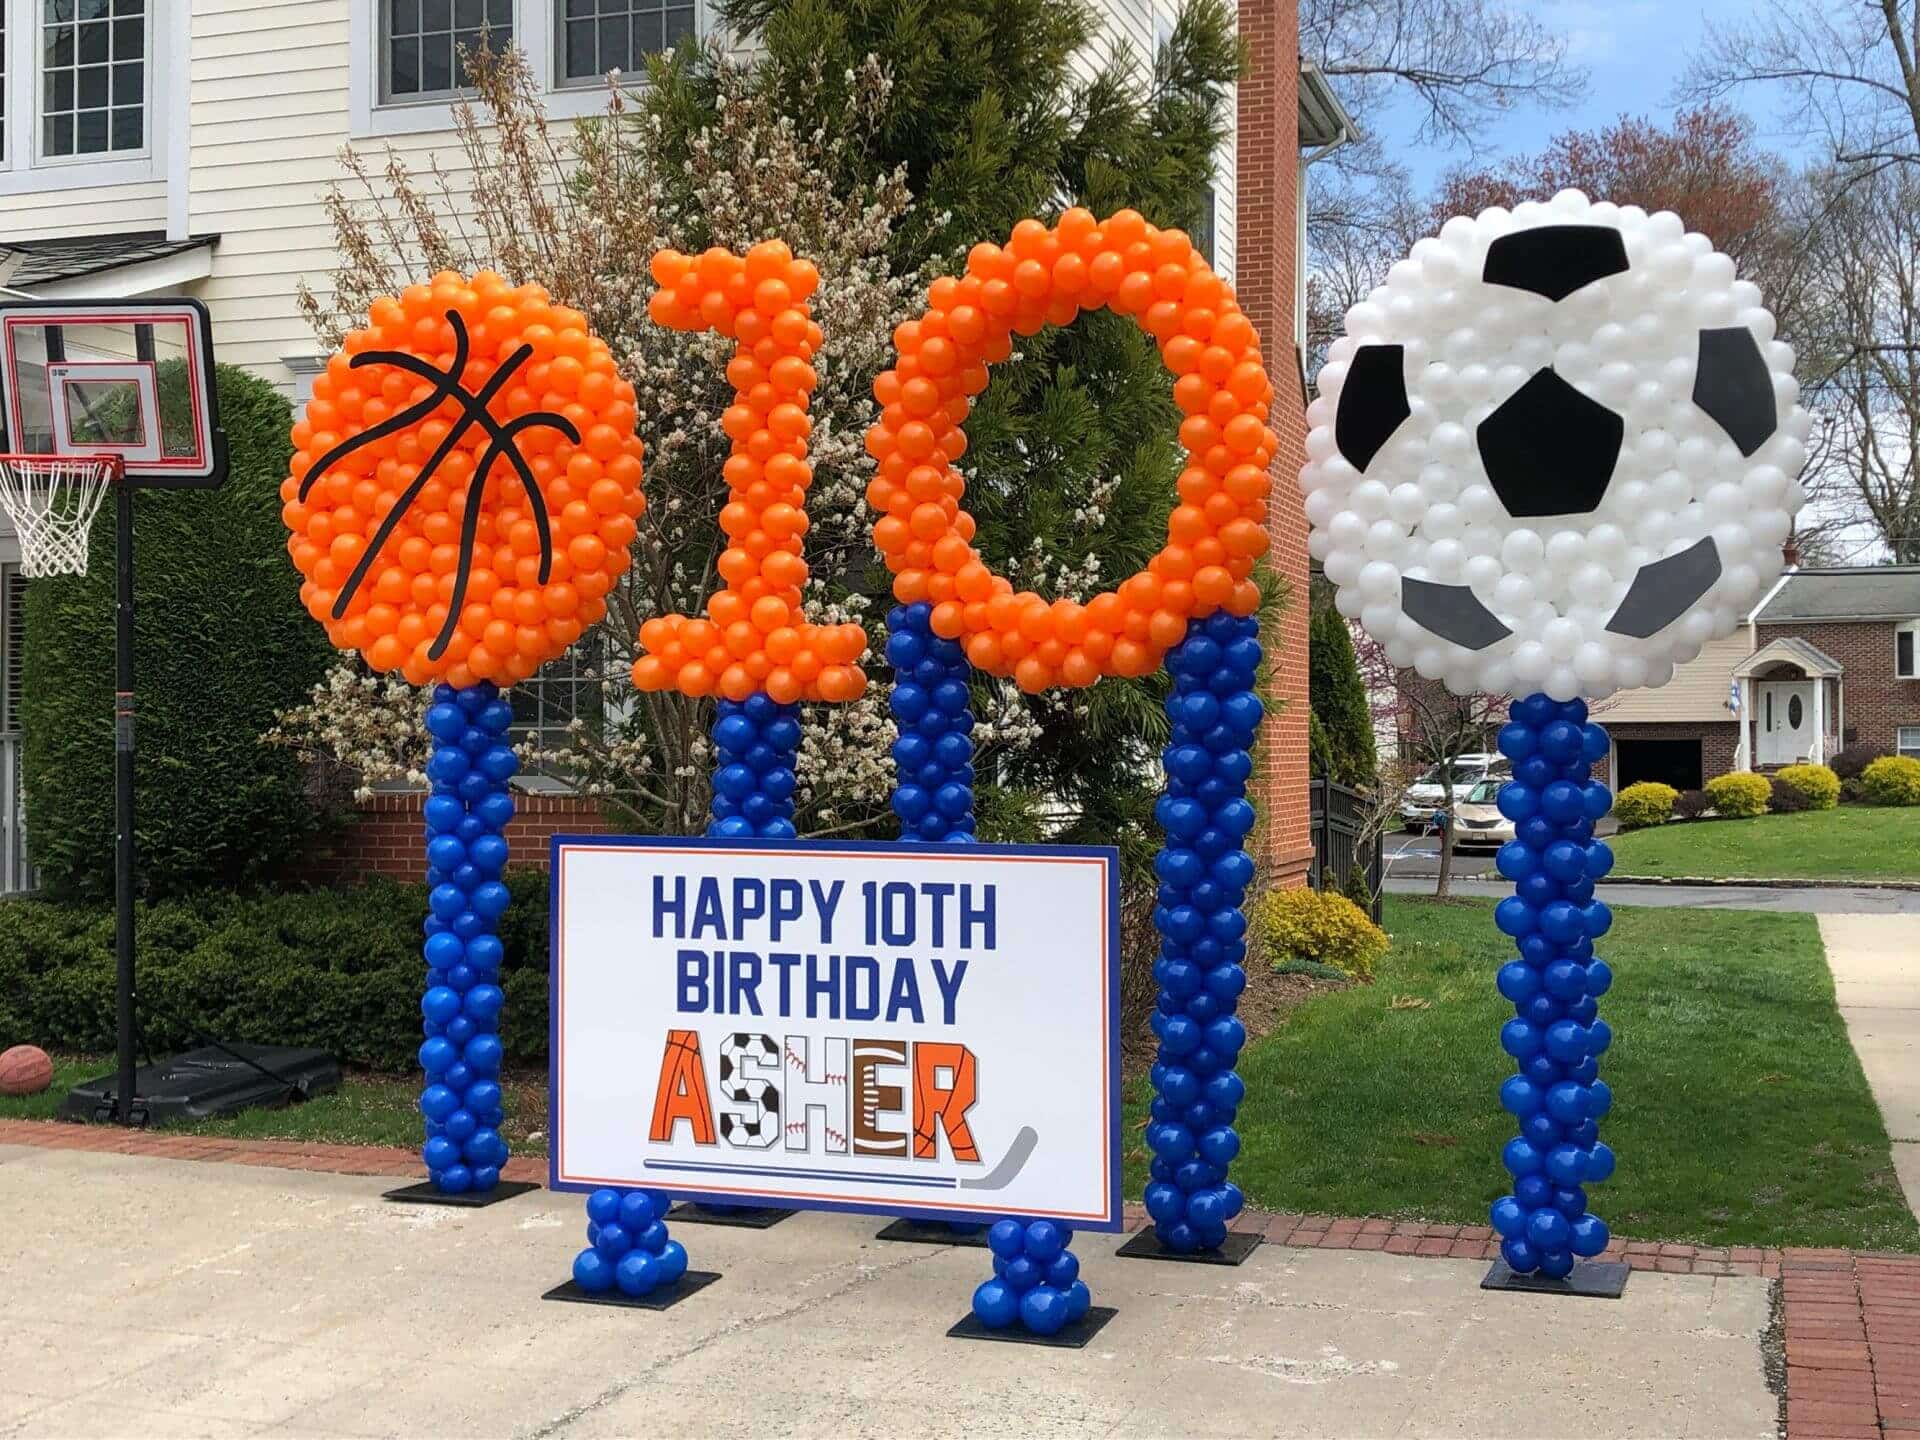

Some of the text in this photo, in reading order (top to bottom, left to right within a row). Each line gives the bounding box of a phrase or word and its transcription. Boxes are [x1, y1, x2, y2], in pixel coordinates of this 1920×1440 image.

[632, 207, 1278, 703] 10
[652, 875, 997, 951] HAPPY 10TH
[676, 949, 968, 1025] BIRTHDAY
[648, 1029, 983, 1163] ASHER
